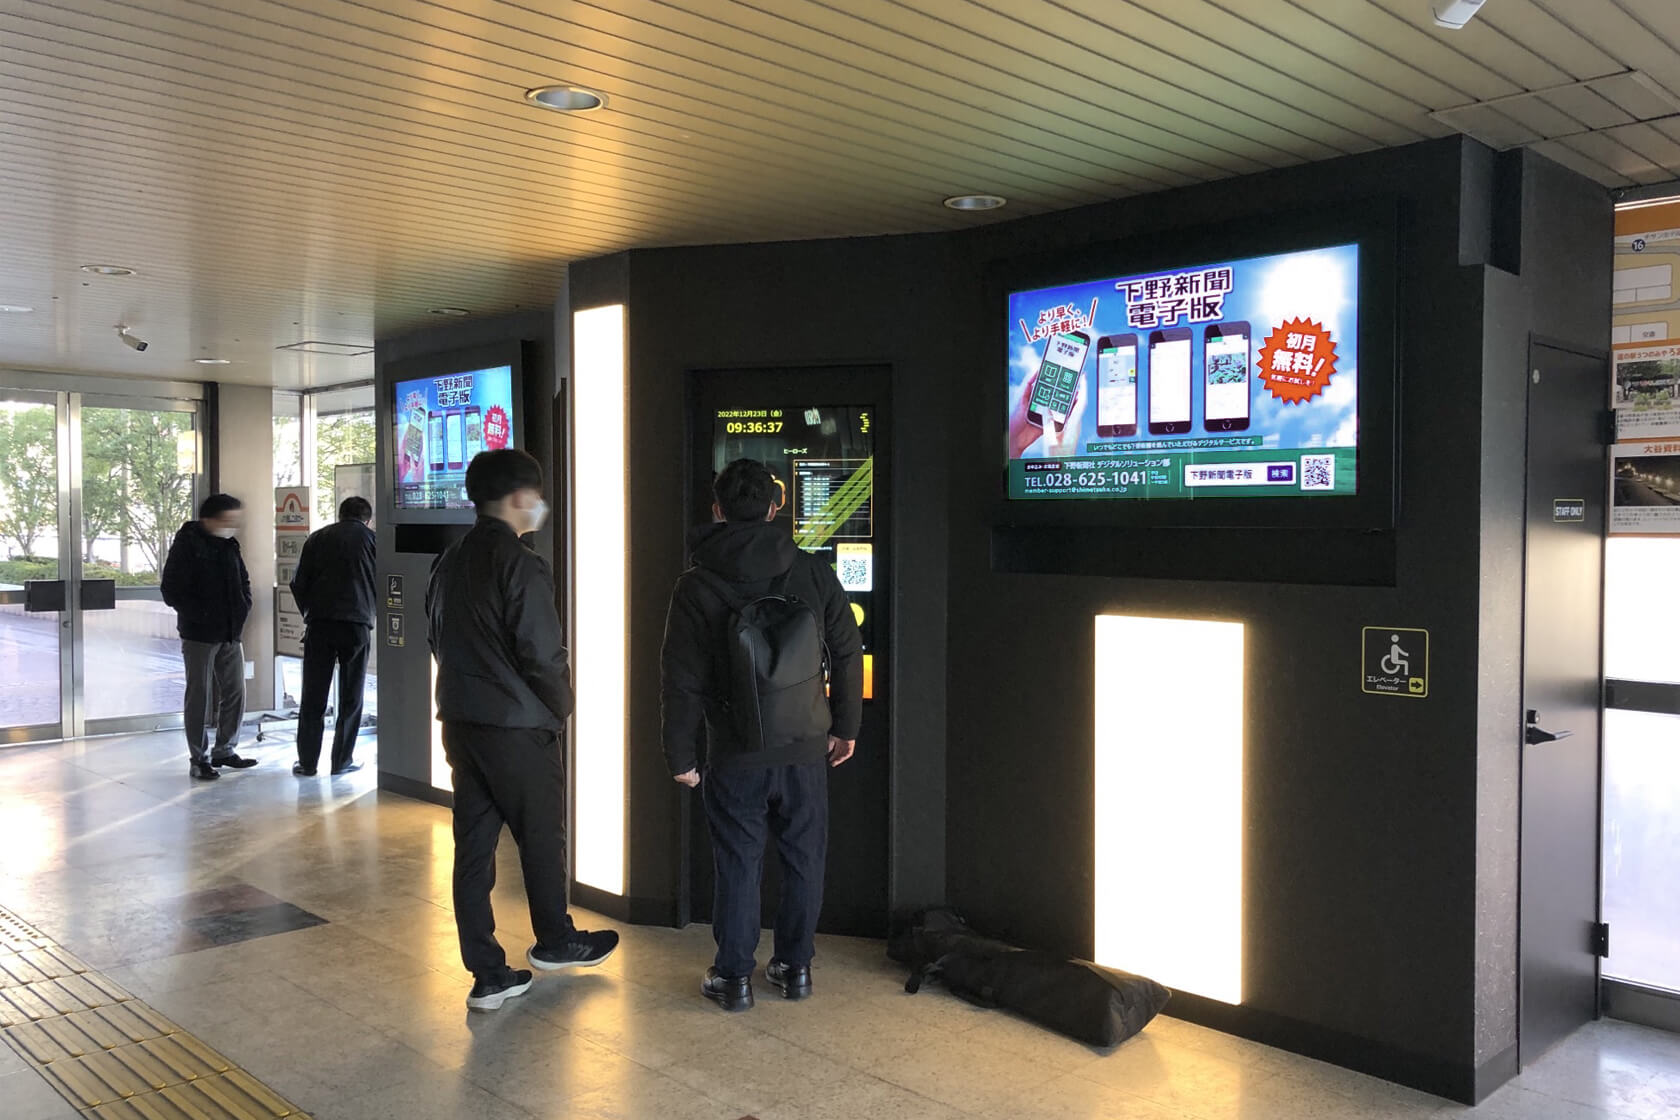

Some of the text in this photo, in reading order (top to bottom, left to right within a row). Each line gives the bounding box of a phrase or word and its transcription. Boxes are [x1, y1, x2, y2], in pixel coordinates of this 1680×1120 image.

[1634, 241, 1644, 250] 16
[1117, 269, 1231, 303] 下野新聞
[1129, 294, 1221, 326] 電子版
[1032, 315, 1088, 341] より手軽に!
[1286, 332, 1317, 352] 初月
[1271, 349, 1326, 377] 無料!
[433, 375, 473, 392] 下野新聞
[438, 389, 471, 406] 電子版
[726, 422, 784, 433] 09:36:37
[1190, 469, 1253, 480] 下野新聞電子版
[1271, 469, 1289, 478] 検索
[1556, 506, 1583, 516] STAFF ONLY
[1367, 675, 1407, 685] エレベーター
